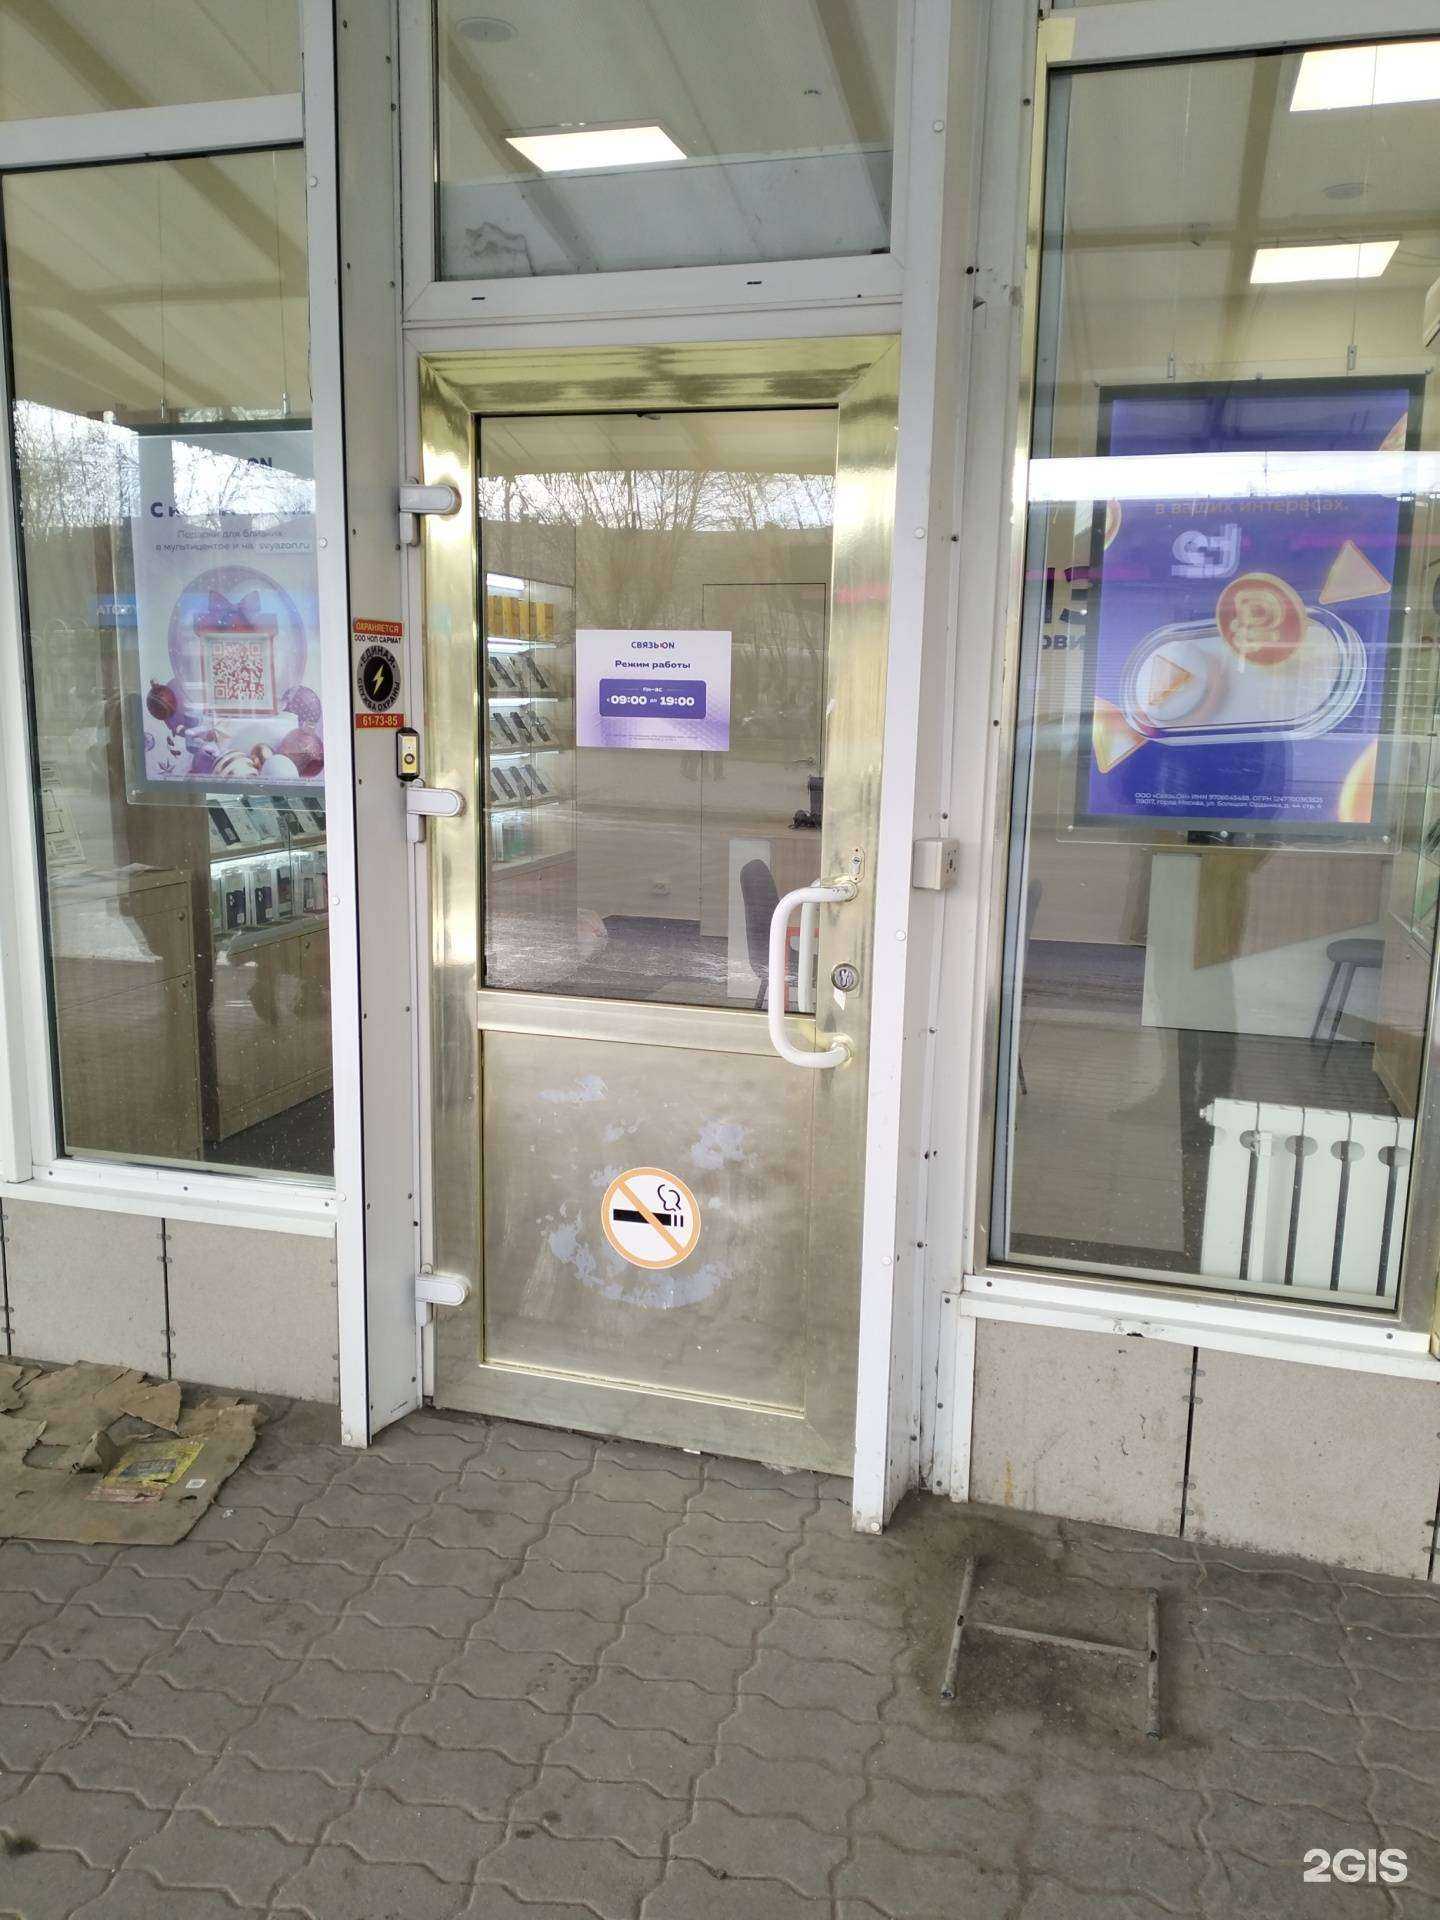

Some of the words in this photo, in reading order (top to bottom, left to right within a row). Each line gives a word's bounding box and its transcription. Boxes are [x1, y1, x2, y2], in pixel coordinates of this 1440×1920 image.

[355, 623, 399, 634] ОХРАНЯЕТСЯ
[361, 645, 396, 665] ЕДИНАЯ
[615, 660, 650, 668] Режим
[652, 661, 691, 670] работы
[377, 681, 400, 710] ОХРАНЫ
[610, 695, 648, 705] 09:00
[660, 696, 695, 706] 19:00
[362, 715, 398, 726] 61-73-85
